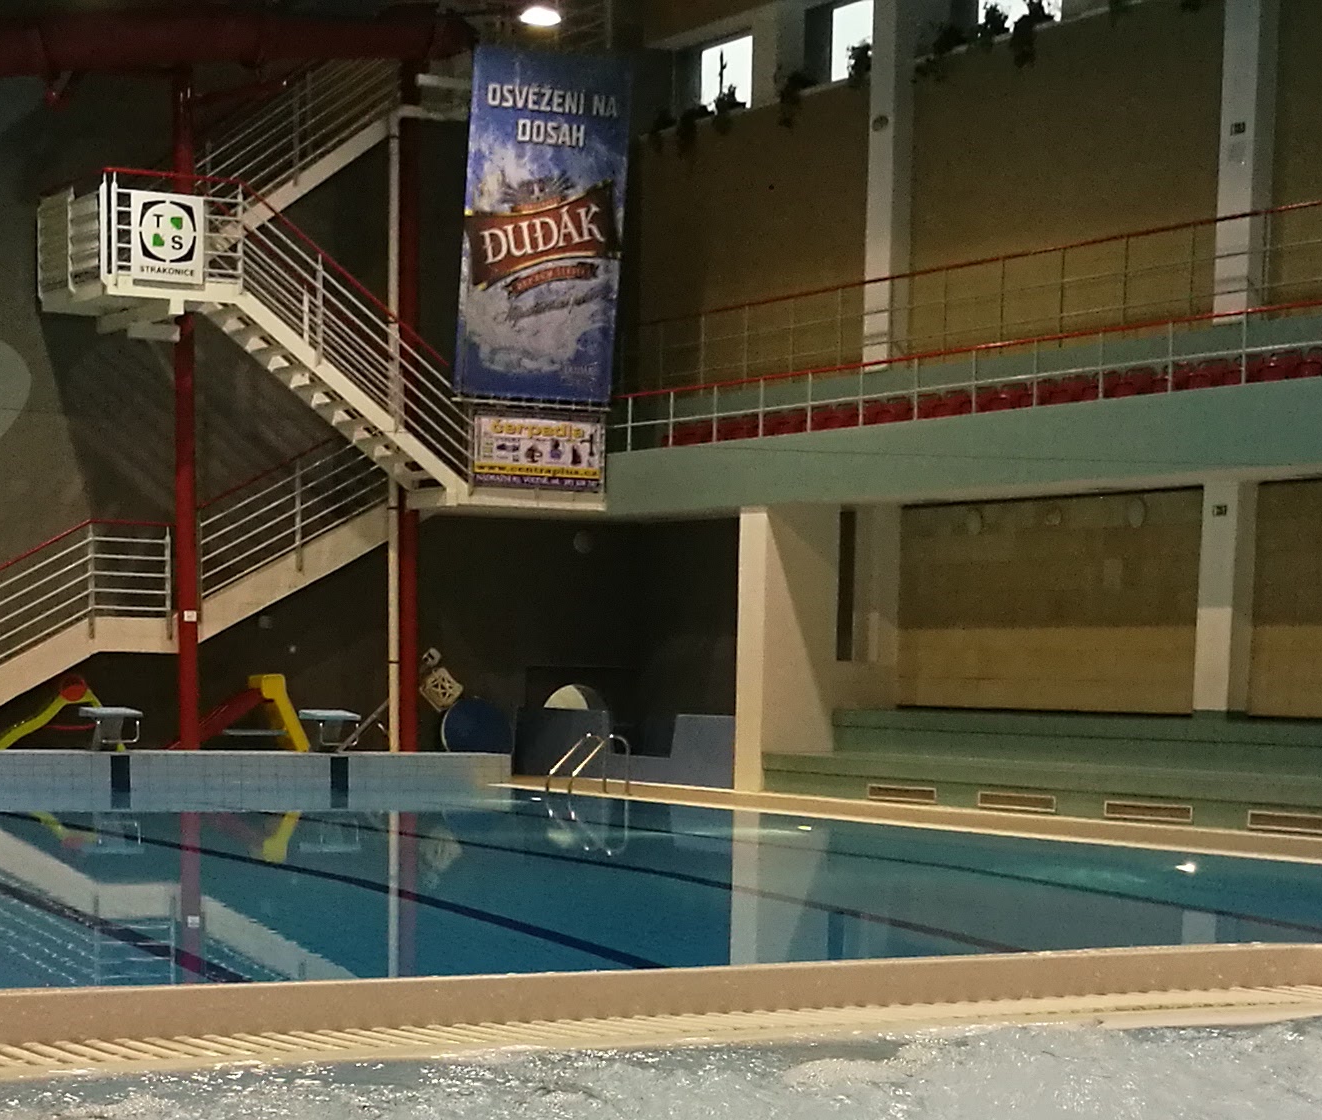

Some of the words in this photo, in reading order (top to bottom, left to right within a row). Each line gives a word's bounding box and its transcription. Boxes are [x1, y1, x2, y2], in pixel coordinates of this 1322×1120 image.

[487, 82, 585, 115] OSVĚŽENÍ
[592, 94, 617, 117] NA
[517, 118, 585, 147] DOSAH
[153, 214, 164, 228] T
[171, 235, 183, 250] S
[479, 203, 606, 264] DUDÁK
[140, 265, 194, 276] STRAKONICE
